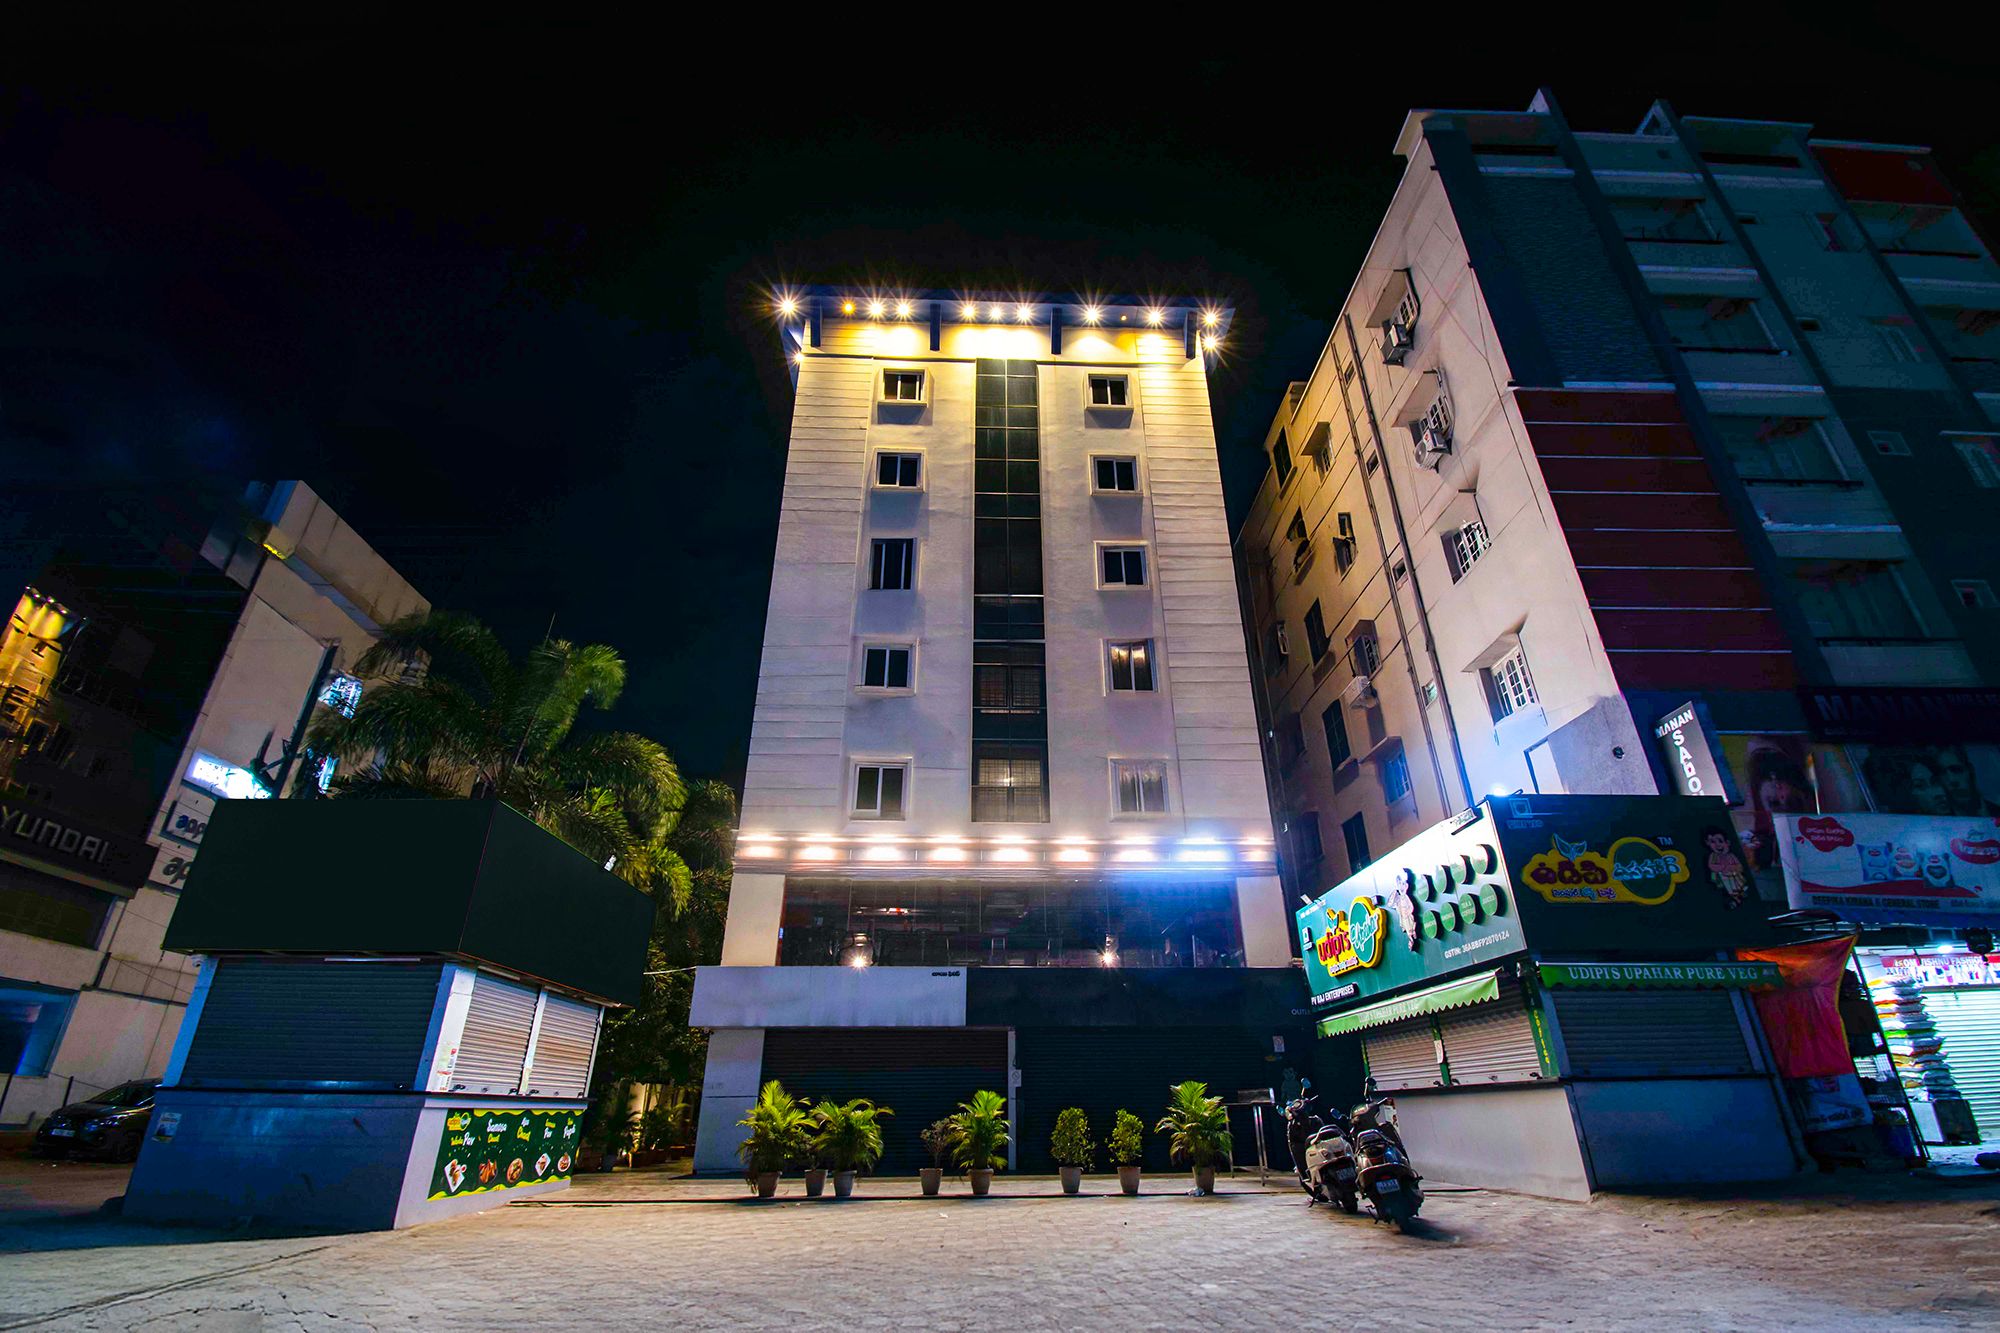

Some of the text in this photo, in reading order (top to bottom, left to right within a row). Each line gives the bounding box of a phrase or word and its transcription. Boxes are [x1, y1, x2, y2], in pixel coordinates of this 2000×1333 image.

[1654, 709, 1694, 739] MANAN
[1623, 966, 1685, 980] UPAHAR
[1687, 966, 1726, 980] PURE
[1728, 966, 1758, 980] VEG
